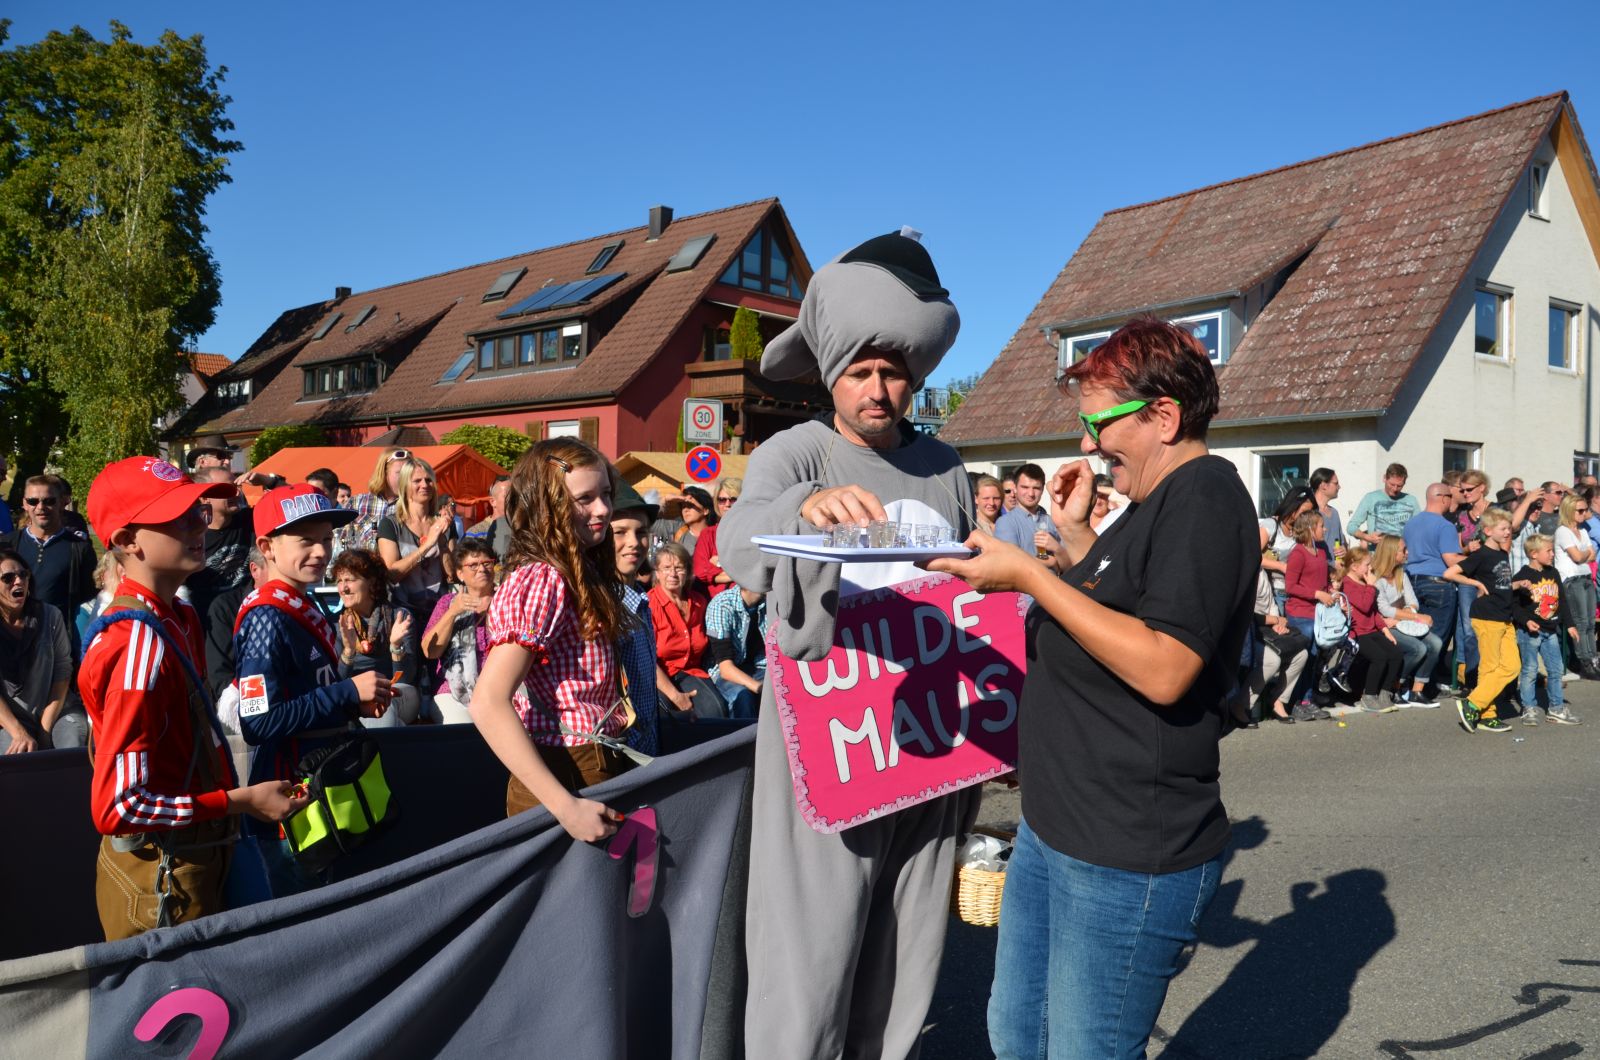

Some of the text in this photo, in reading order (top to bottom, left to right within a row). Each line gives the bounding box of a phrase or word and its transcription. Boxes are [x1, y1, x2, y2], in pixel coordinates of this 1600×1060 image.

[697, 411, 711, 424] 30
[796, 590, 992, 698] WILDE
[828, 663, 1018, 784] MAUS
